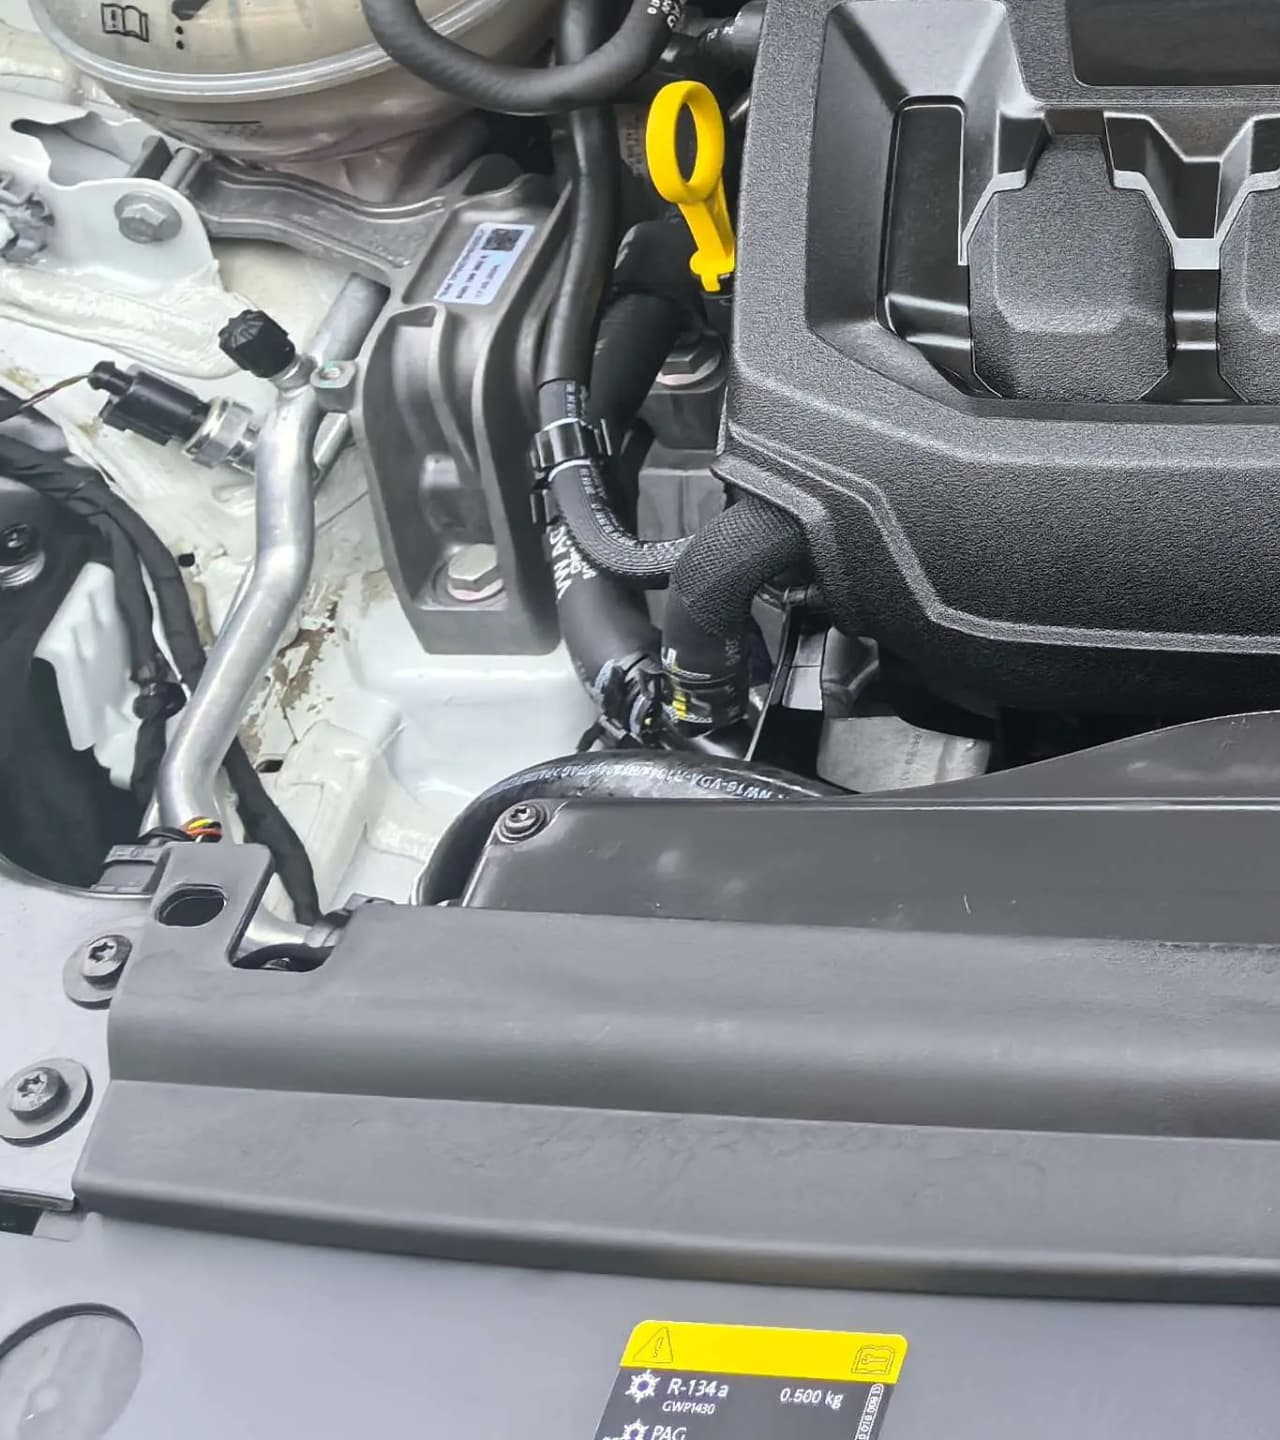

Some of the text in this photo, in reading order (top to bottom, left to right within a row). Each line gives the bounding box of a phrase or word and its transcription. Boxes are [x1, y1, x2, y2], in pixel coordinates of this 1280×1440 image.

[780, 1387, 822, 1404] 0.500
[824, 1390, 844, 1410] kg
[661, 1400, 716, 1415] GWP1430
[650, 1425, 687, 1440] PAG
